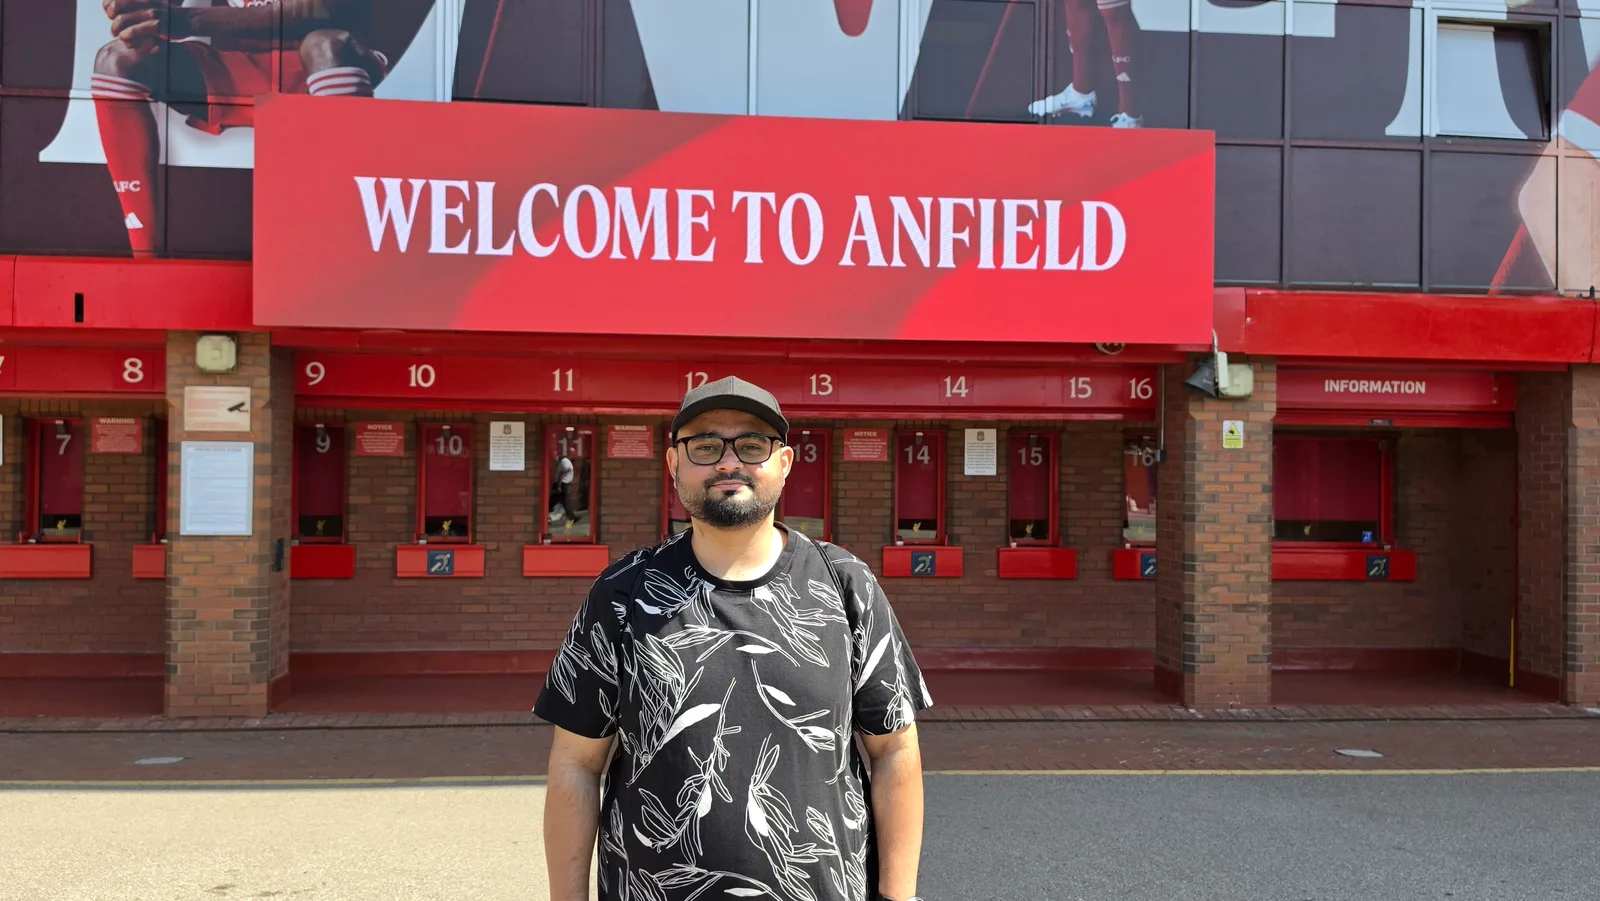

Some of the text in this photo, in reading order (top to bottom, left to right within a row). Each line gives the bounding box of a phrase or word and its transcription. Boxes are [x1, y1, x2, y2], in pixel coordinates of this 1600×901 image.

[353, 175, 1127, 272] WELCOME TO ANFIELD
[122, 357, 144, 383] 8
[305, 361, 326, 386] 9
[408, 364, 436, 388] 10
[552, 368, 574, 392] 11
[809, 373, 834, 396] 13
[943, 376, 969, 398] 14
[1068, 377, 1092, 399] 15
[1128, 378, 1153, 400] 16
[1324, 379, 1426, 395] INFORMATION
[99, 417, 136, 425] WARNING
[56, 434, 71, 455] 7
[316, 434, 330, 453] 9
[436, 435, 463, 456] 10
[558, 437, 583, 457] 11
[904, 445, 930, 465] 14
[1018, 447, 1043, 466] 15
